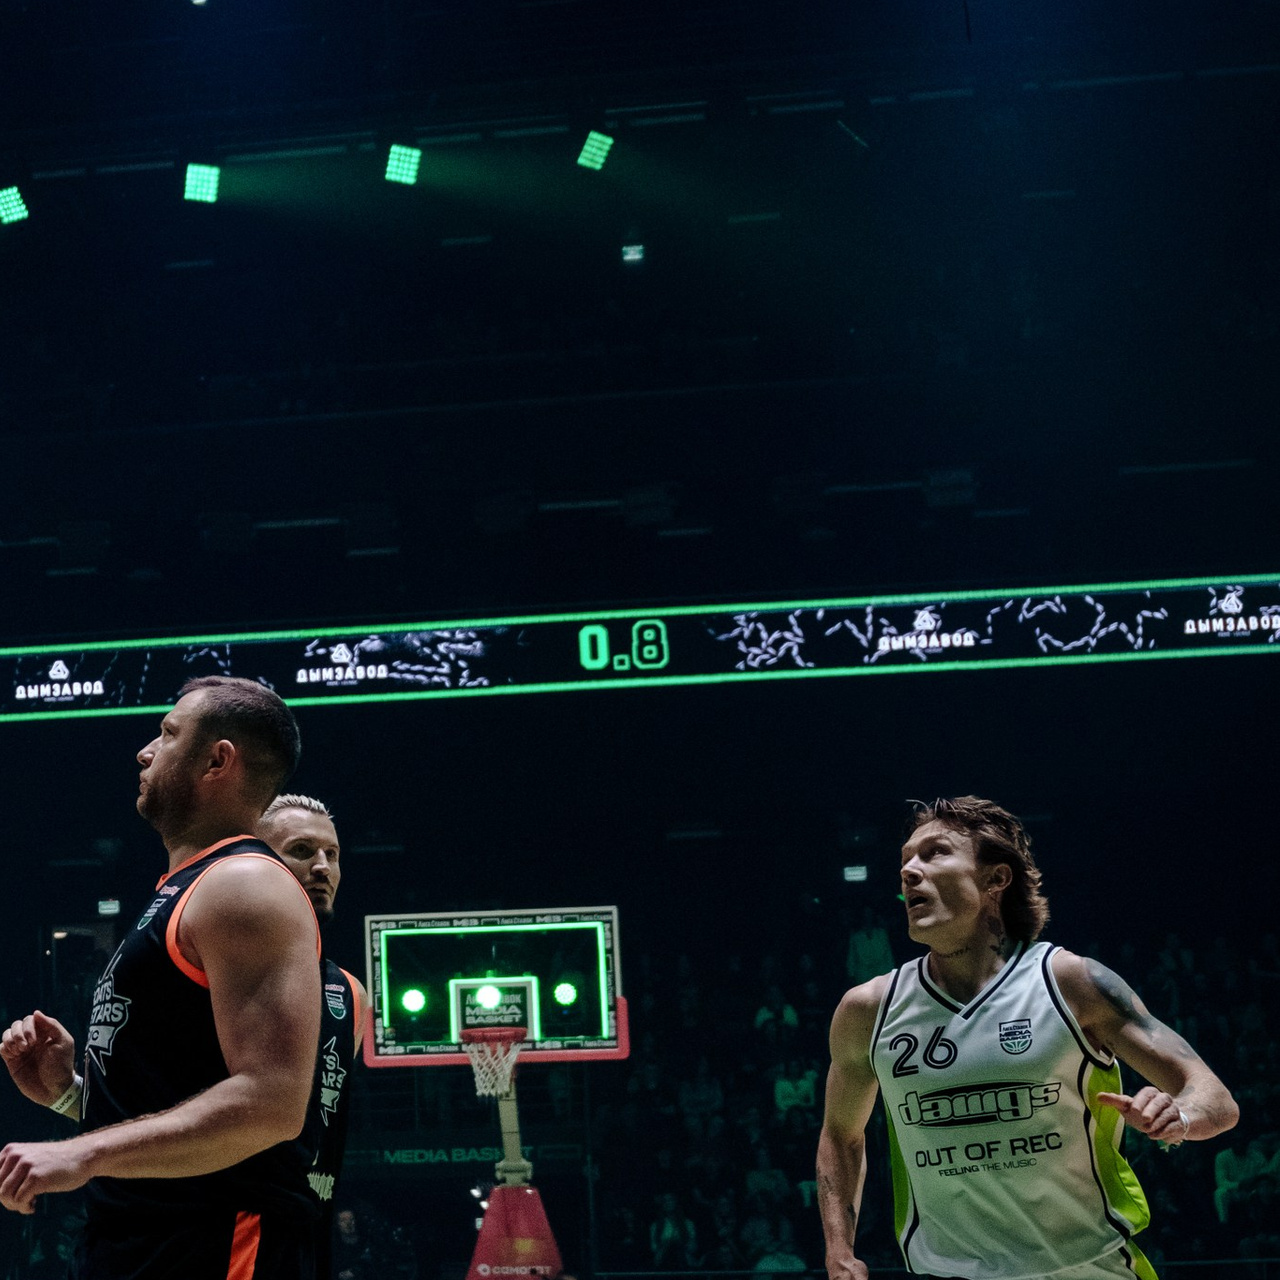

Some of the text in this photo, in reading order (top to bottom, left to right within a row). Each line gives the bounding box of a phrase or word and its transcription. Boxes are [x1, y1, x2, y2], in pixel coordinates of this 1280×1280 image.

[578, 618, 670, 671] 0.8
[877, 631, 976, 652] ДЫМЗАВОД
[295, 664, 389, 684] ДЫМЗАВОД
[14, 679, 105, 700] ДЫМЗАВОД
[466, 1014, 523, 1024] BASKET
[889, 1026, 958, 1078] 26
[898, 1082, 1062, 1125] dawgs
[383, 1146, 534, 1164] MEDIA BAST
[915, 1132, 1063, 1168] OUT OF REC
[938, 1157, 1038, 1177] FEELING THE MUSIC
